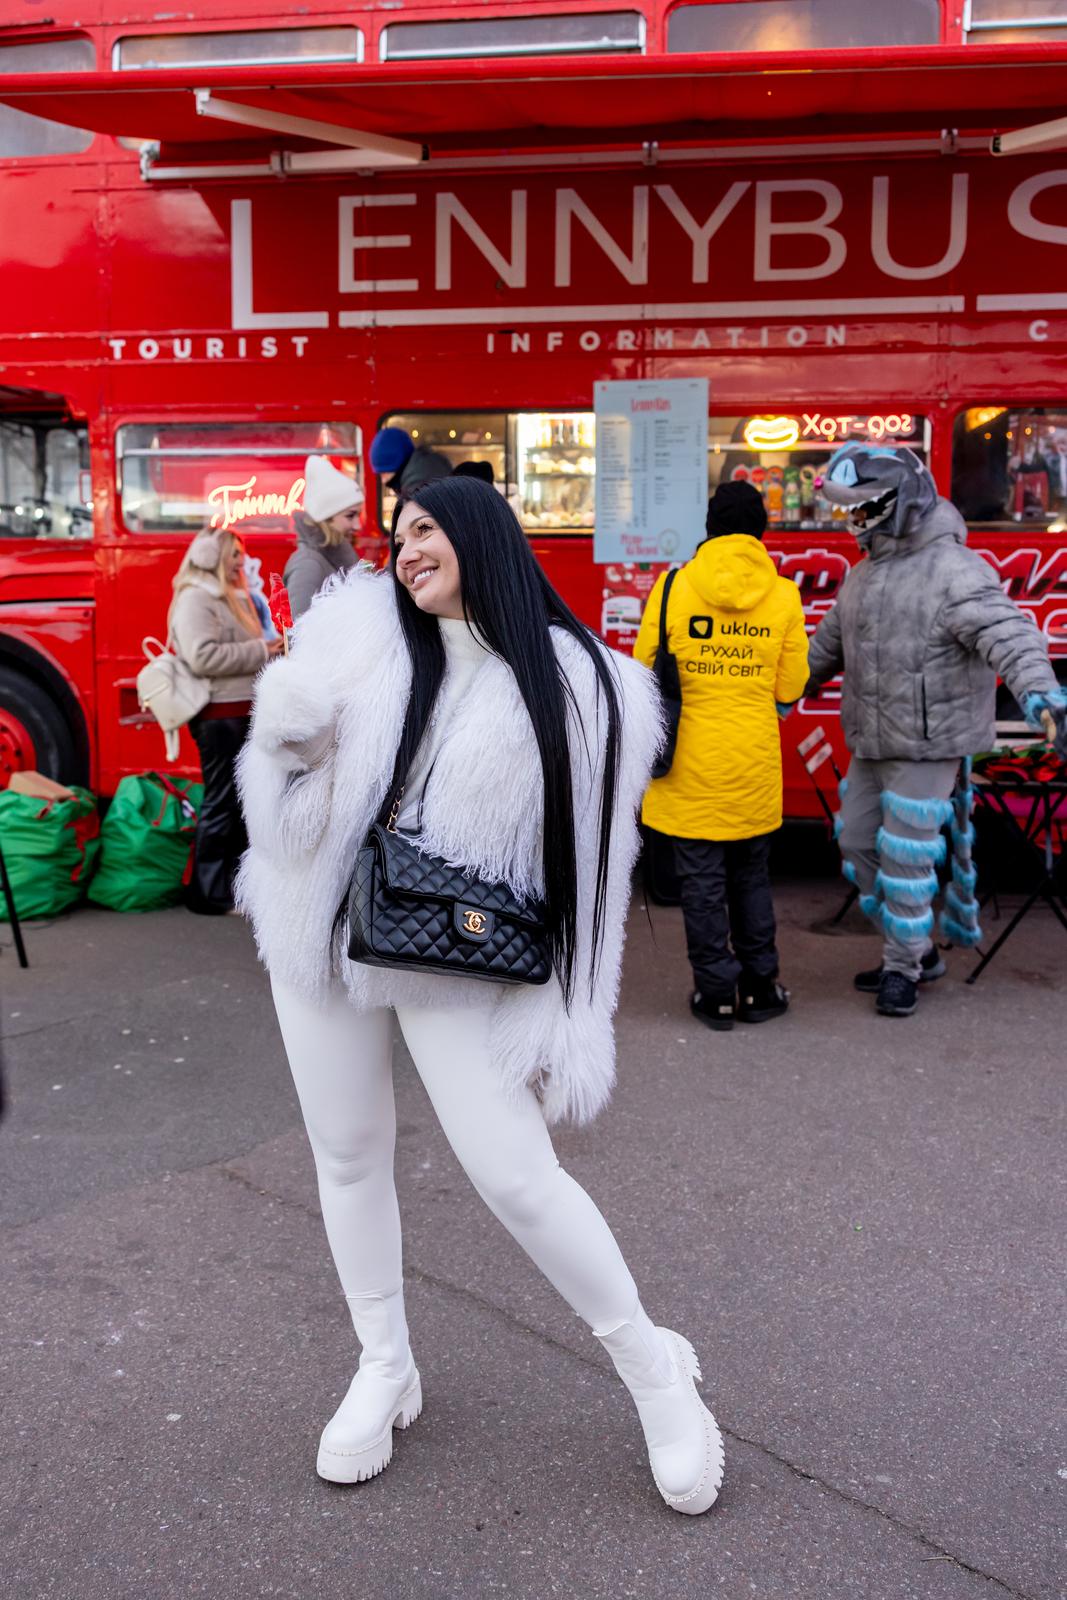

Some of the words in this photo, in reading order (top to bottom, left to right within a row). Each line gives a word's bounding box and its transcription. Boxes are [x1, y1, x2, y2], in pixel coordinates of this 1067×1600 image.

[108, 336, 309, 360] TOURIST
[486, 325, 847, 353] INFORMATION
[720, 621, 771, 638] uklon
[700, 644, 754, 660] РУХАЙ
[684, 660, 724, 676] СВІЙ
[728, 664, 764, 677] СВІТ
